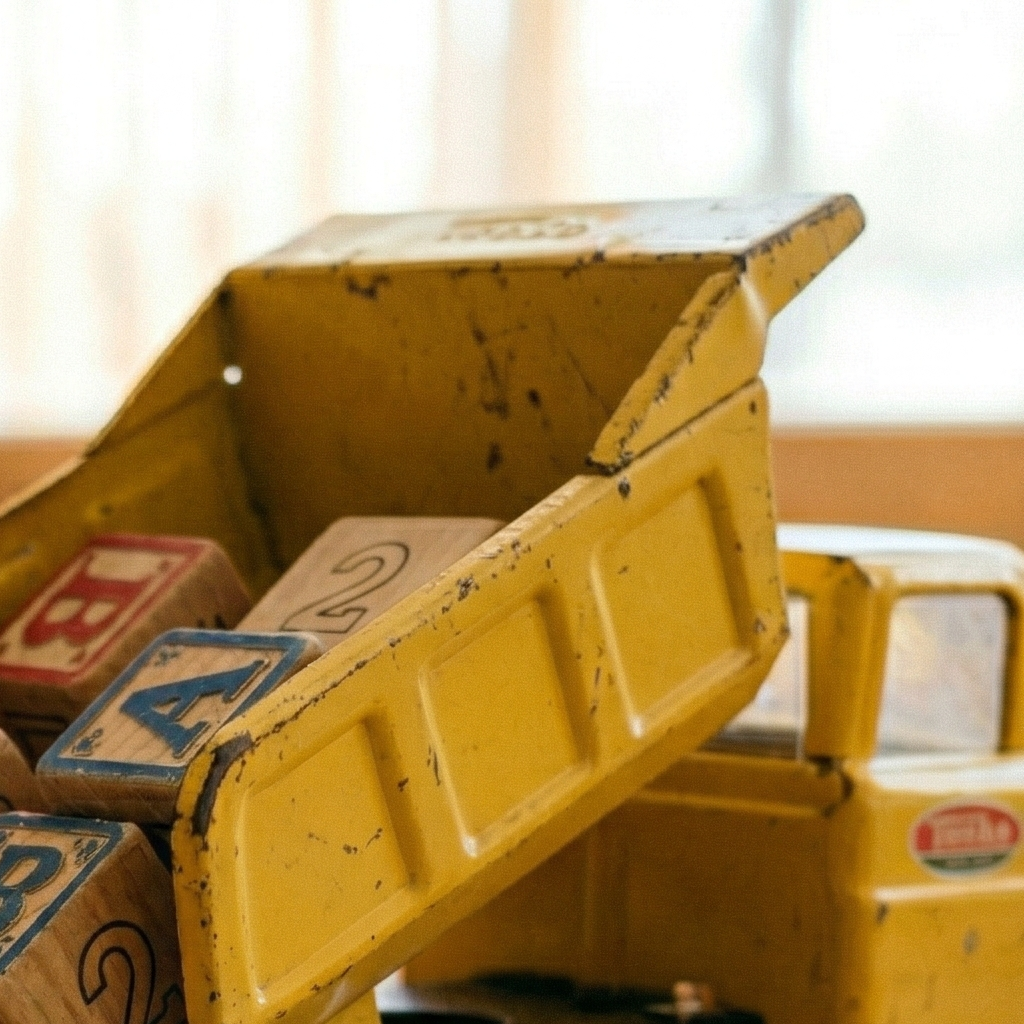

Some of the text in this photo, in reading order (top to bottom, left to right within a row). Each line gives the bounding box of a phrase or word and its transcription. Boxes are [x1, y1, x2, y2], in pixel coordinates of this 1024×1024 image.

[22, 570, 154, 648] B
[276, 541, 410, 634] 2
[119, 657, 272, 759] A
